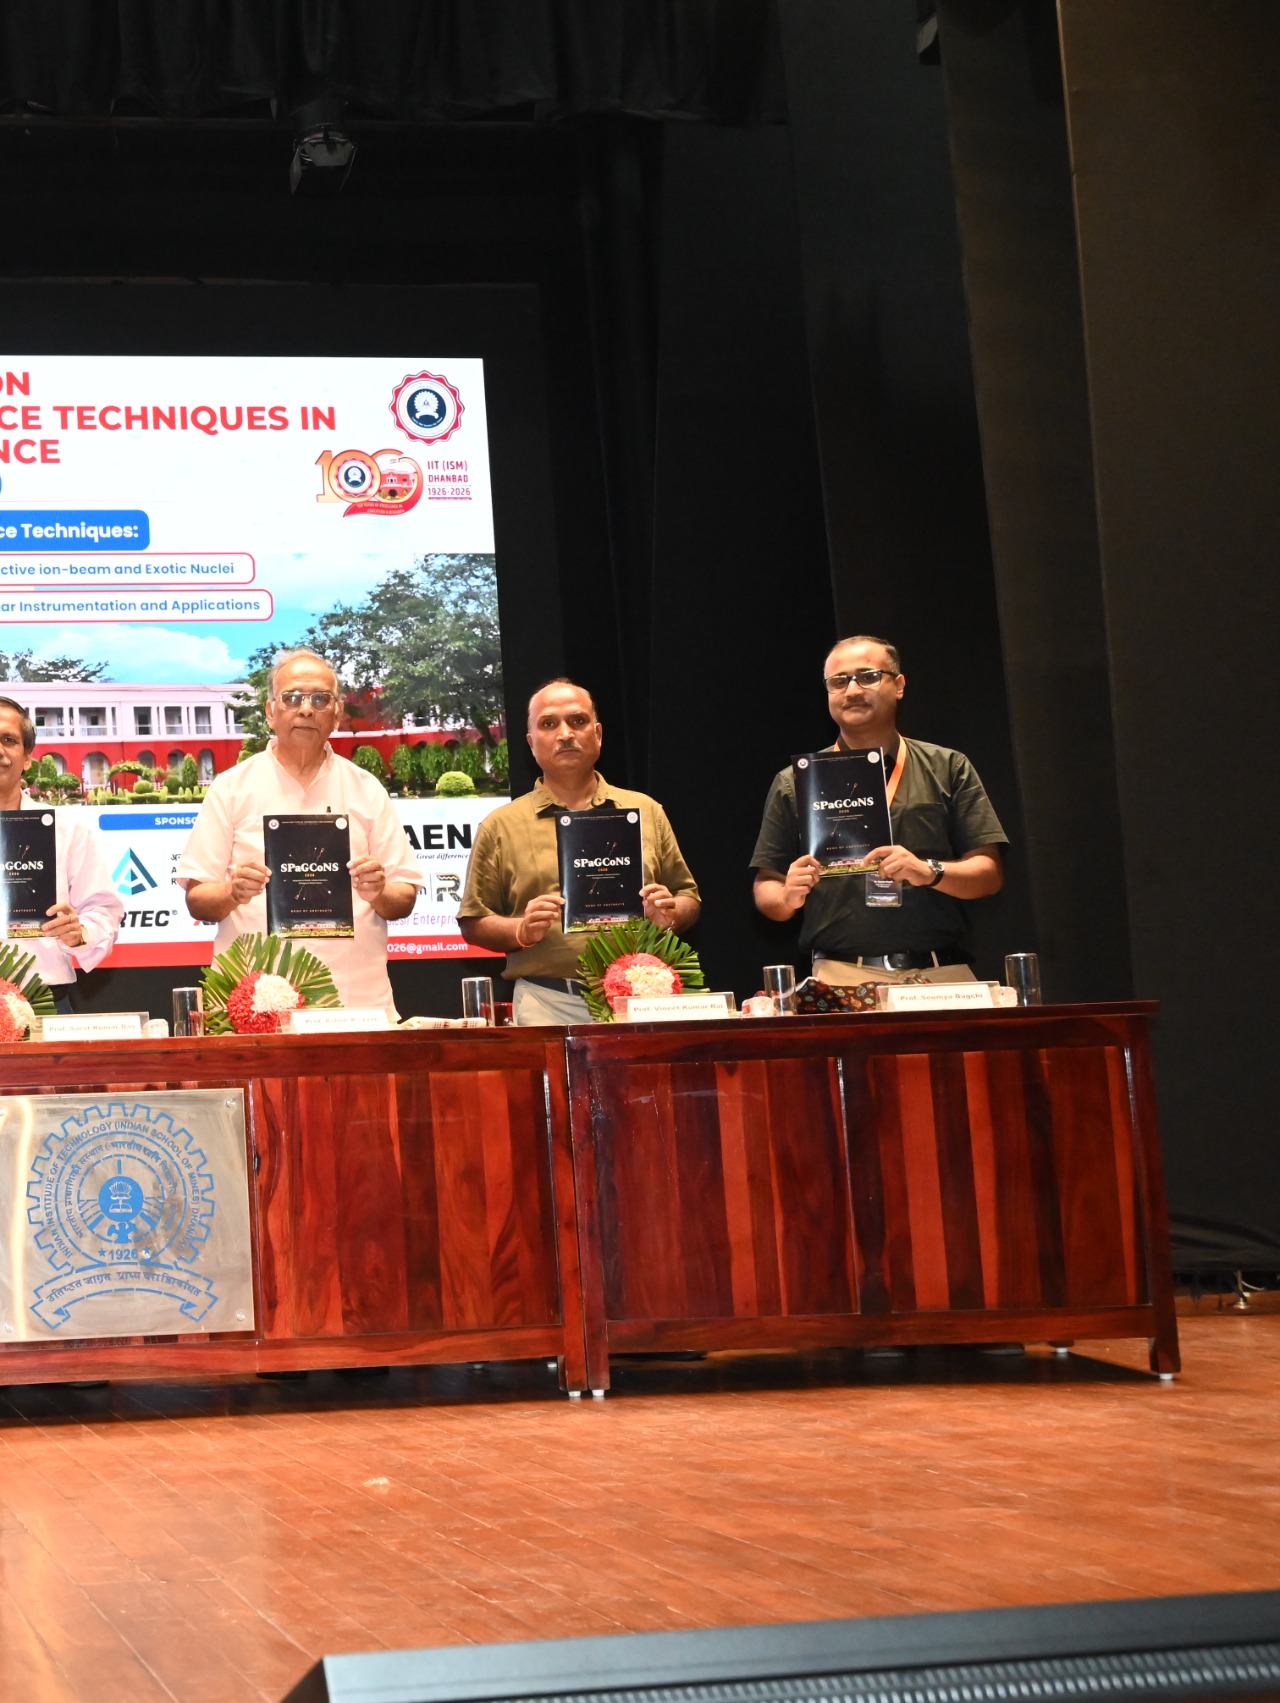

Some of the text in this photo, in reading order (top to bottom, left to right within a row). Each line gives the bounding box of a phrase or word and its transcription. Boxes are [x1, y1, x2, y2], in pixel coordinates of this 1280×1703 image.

[52, 405, 289, 436] TECHNIQUES
[300, 406, 336, 431] IN
[427, 460, 468, 472] IIT (ISM)
[428, 474, 469, 483] DHANBAD
[427, 487, 471, 496] 1926-2026
[20, 521, 139, 543] Techniques:
[39, 563, 111, 575] ion-beam
[114, 563, 142, 575] and
[145, 562, 187, 575] Exotic
[190, 562, 234, 574] Nuclei
[19, 599, 137, 612] Instrumentation
[140, 599, 168, 611] and
[171, 598, 260, 614] Applications
[812, 796, 874, 811] SPaGCoNS
[280, 862, 339, 873] SPaGCoNS
[573, 856, 631, 868] SPaGCoNS
[50, 1161, 60, 1175] OF
[56, 1121, 112, 1161] TECHNOLOGY
[114, 1121, 150, 1134] (INDIAN
[150, 1128, 181, 1158] SCHOOL
[182, 1157, 193, 1170] OF
[188, 1171, 200, 1205] MINES)
[108, 1248, 139, 1260] 1926
